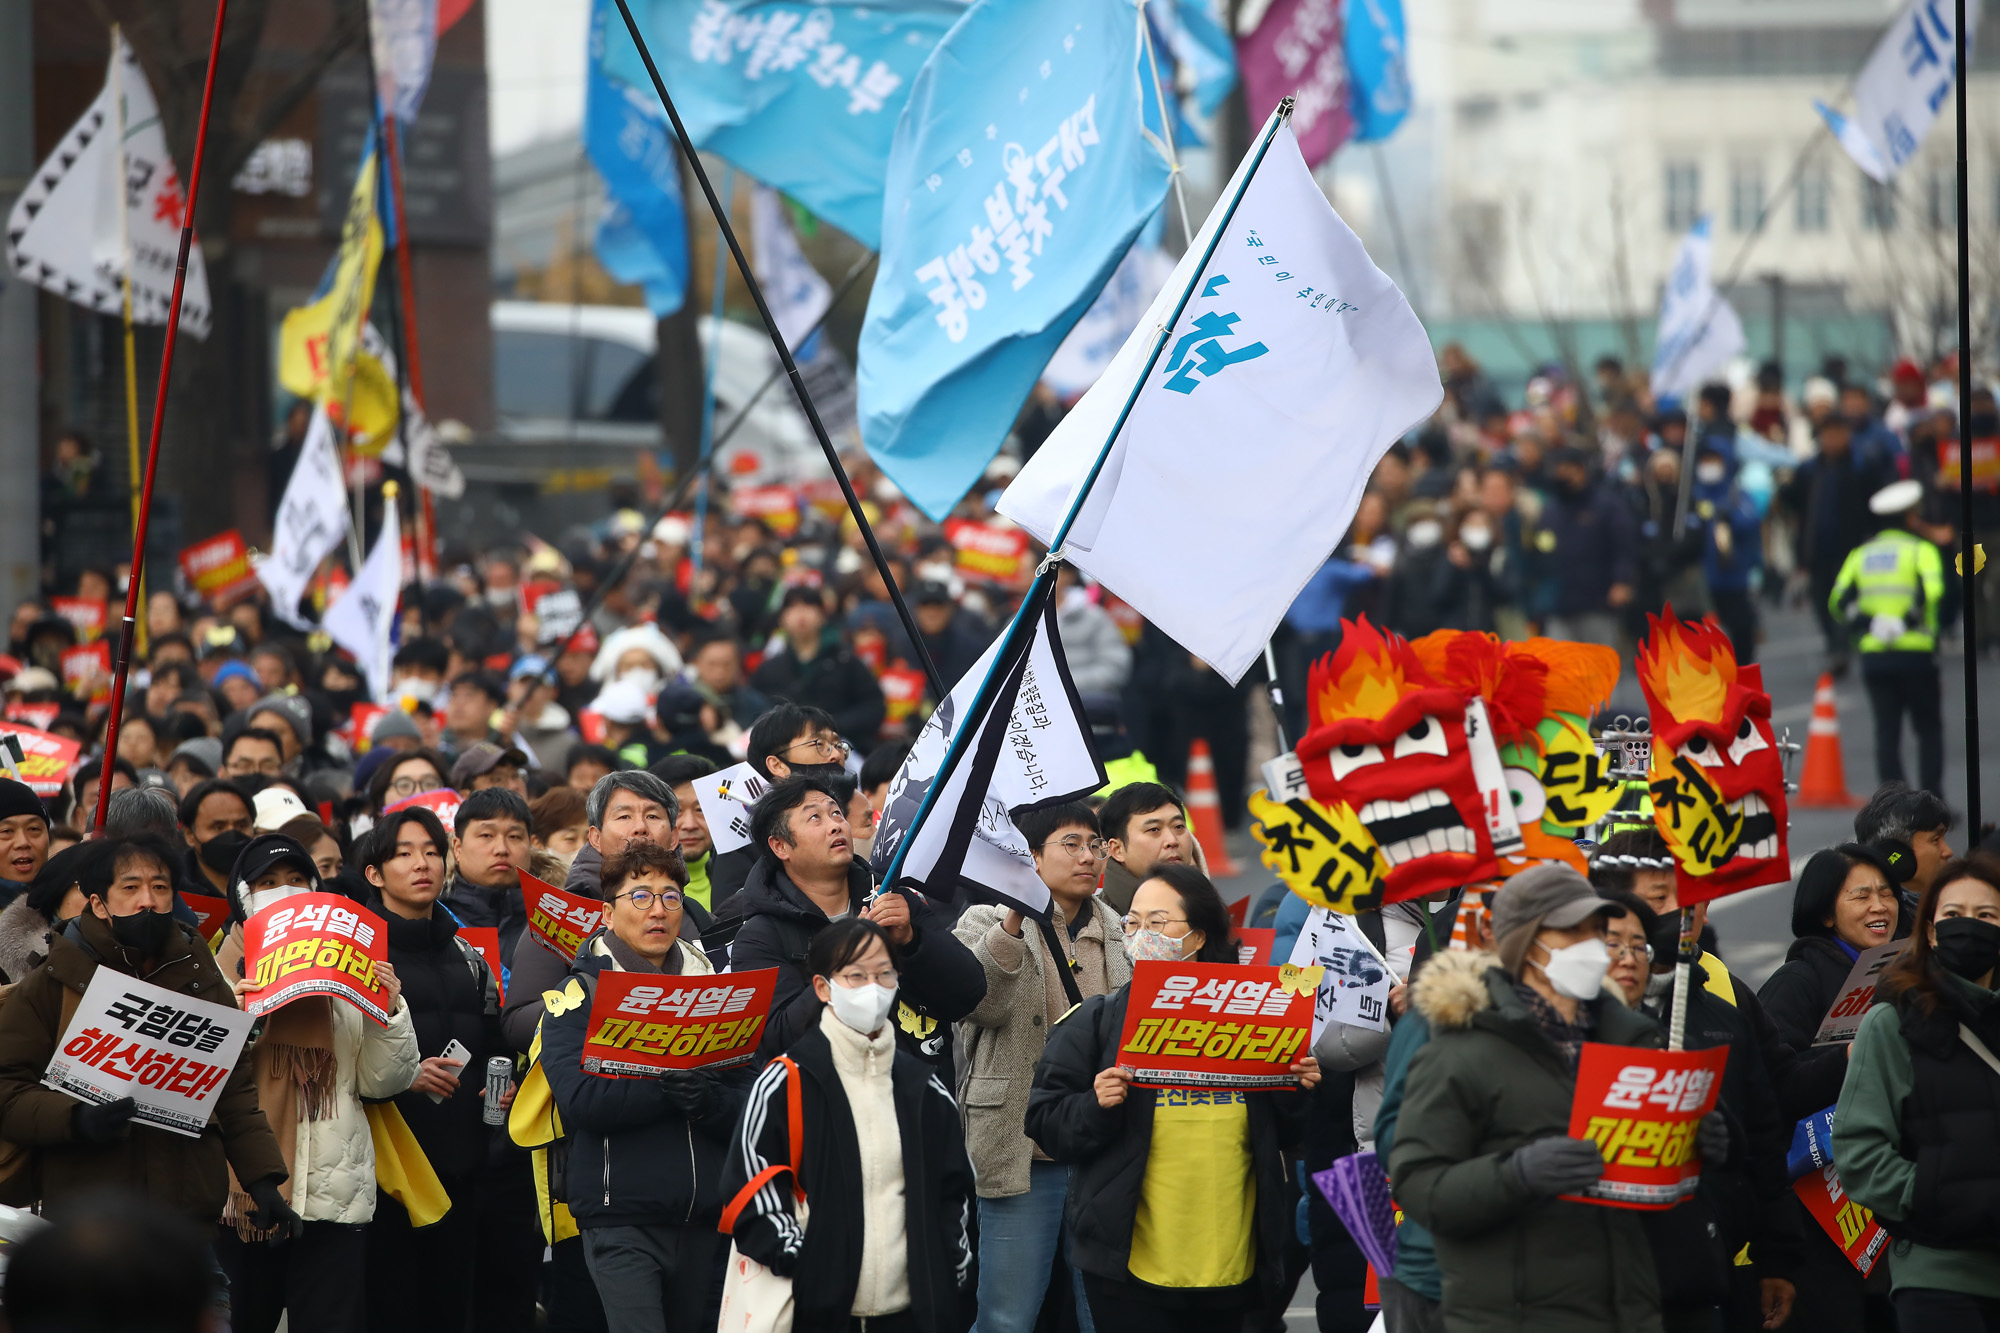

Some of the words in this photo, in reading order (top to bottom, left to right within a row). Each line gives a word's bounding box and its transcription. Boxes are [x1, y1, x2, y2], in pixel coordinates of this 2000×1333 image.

[1542, 751, 1614, 823] 단
[261, 904, 376, 949] 윤석열을
[538, 892, 606, 933] 윤석
[616, 985, 756, 1018] 윤석열을
[1151, 975, 1295, 1017] 윤석열을
[104, 991, 231, 1054] 국힘당을
[588, 1014, 765, 1058] 파면하라!
[1122, 1018, 1308, 1064] 파면하라!
[62, 1025, 230, 1102] 해산하라!
